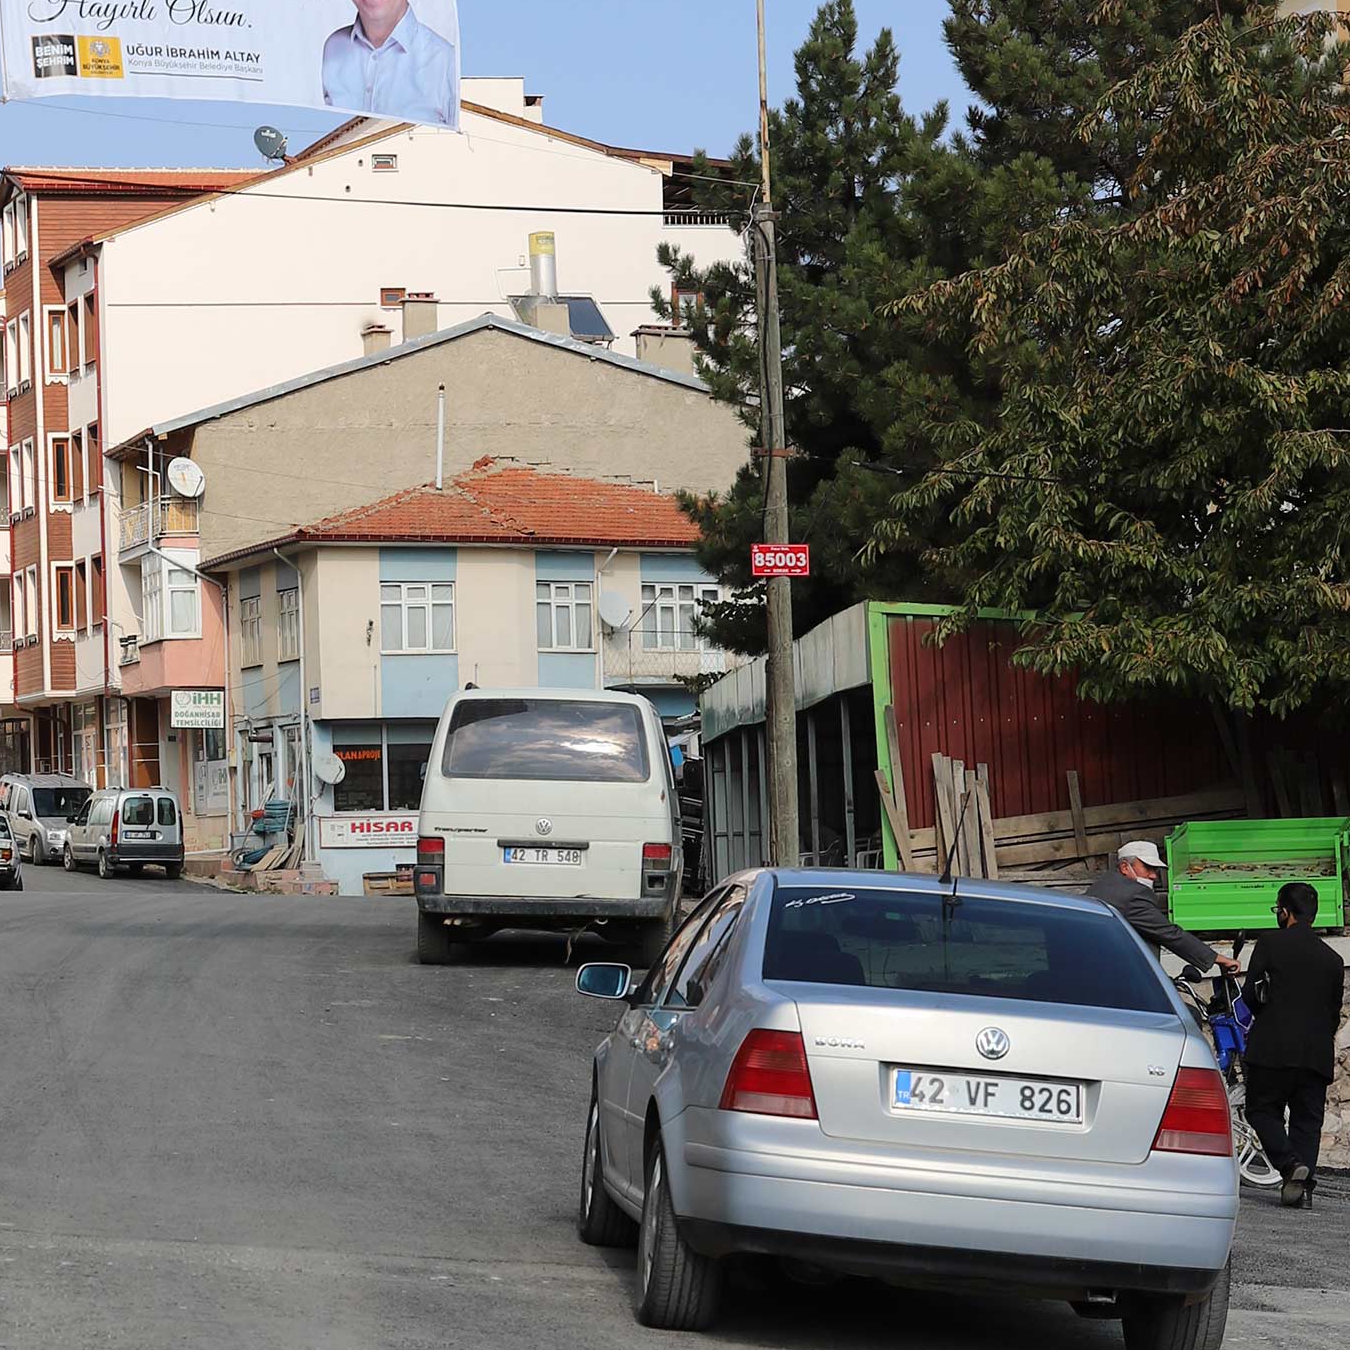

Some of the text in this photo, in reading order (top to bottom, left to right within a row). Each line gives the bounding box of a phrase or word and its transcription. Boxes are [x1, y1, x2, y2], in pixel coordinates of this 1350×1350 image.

[35, 44, 74, 58] BENİM
[126, 43, 261, 64] UĞUR İBRAHİM ALTAY
[36, 55, 75, 69] ŞEHRİM
[128, 59, 153, 68] Konya
[199, 61, 233, 71] Belediye
[755, 553, 807, 567] 85003
[511, 849, 580, 863] 42 TR 548
[898, 1076, 1072, 1115] TR 42 VF 826
